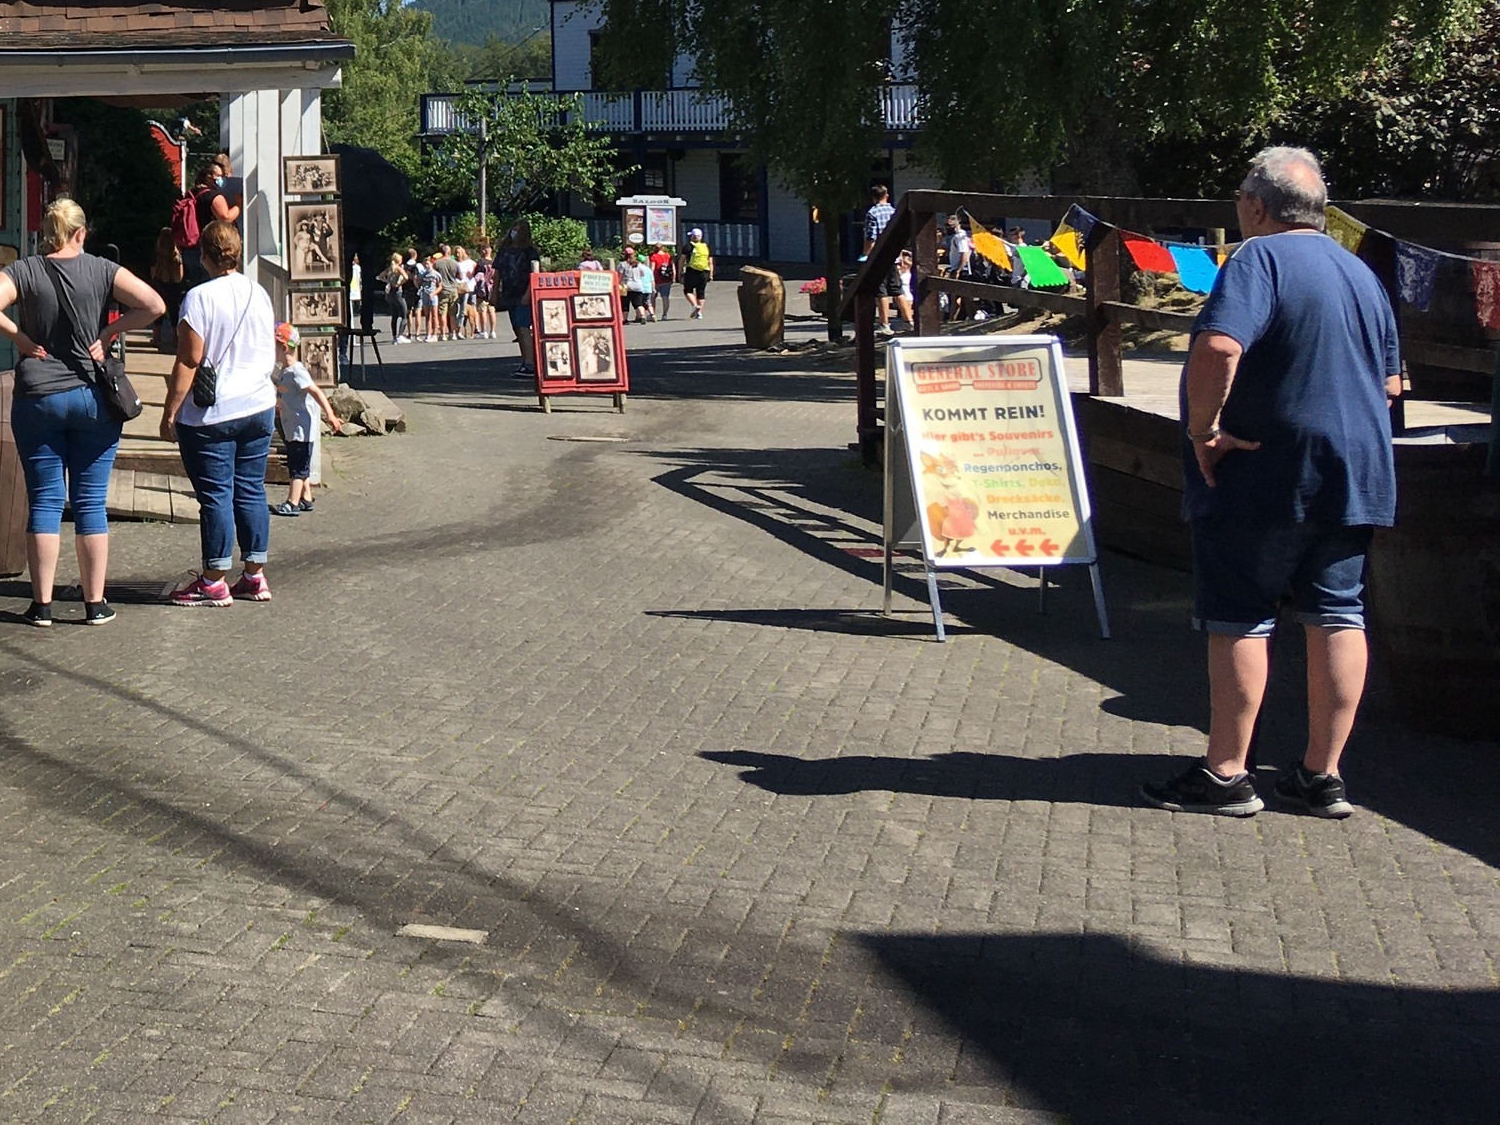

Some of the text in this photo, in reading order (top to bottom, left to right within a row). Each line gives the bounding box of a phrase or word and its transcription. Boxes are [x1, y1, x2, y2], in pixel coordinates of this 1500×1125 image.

[916, 362, 1037, 380] GENERAL STORE
[922, 405, 1046, 421] KOMMT REIN!
[922, 428, 1054, 443] Hier gibt's Souvenirs
[963, 462, 1063, 474] Regenponchos,
[987, 509, 1070, 520] Merchandise
[1008, 527, 1046, 536] u.v.m.
